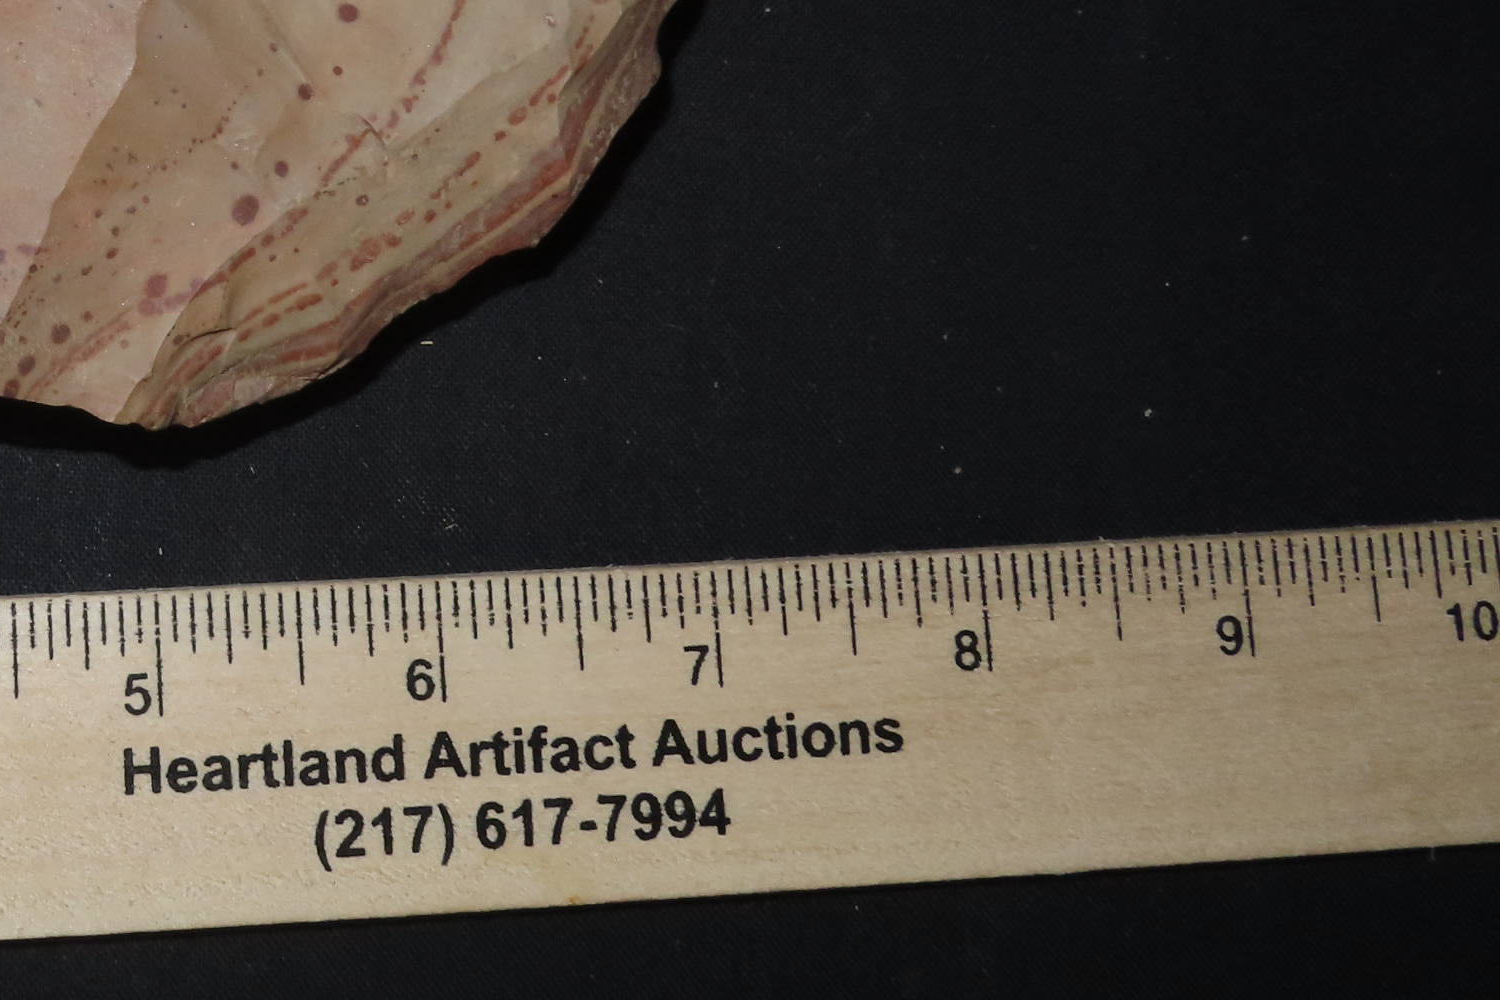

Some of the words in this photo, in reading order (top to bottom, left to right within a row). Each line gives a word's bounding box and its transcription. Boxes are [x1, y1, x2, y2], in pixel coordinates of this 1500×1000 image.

[125, 673, 151, 716] 5
[407, 659, 435, 701] 6
[684, 645, 709, 685] 7
[955, 630, 982, 671] 8
[1216, 616, 1243, 655] 9
[1447, 601, 1499, 641] 10
[124, 734, 405, 795] Heartland
[424, 724, 636, 779] Artifact
[653, 713, 903, 766] Auctions
[315, 803, 454, 872] (217)
[476, 788, 731, 850] 617-7994
